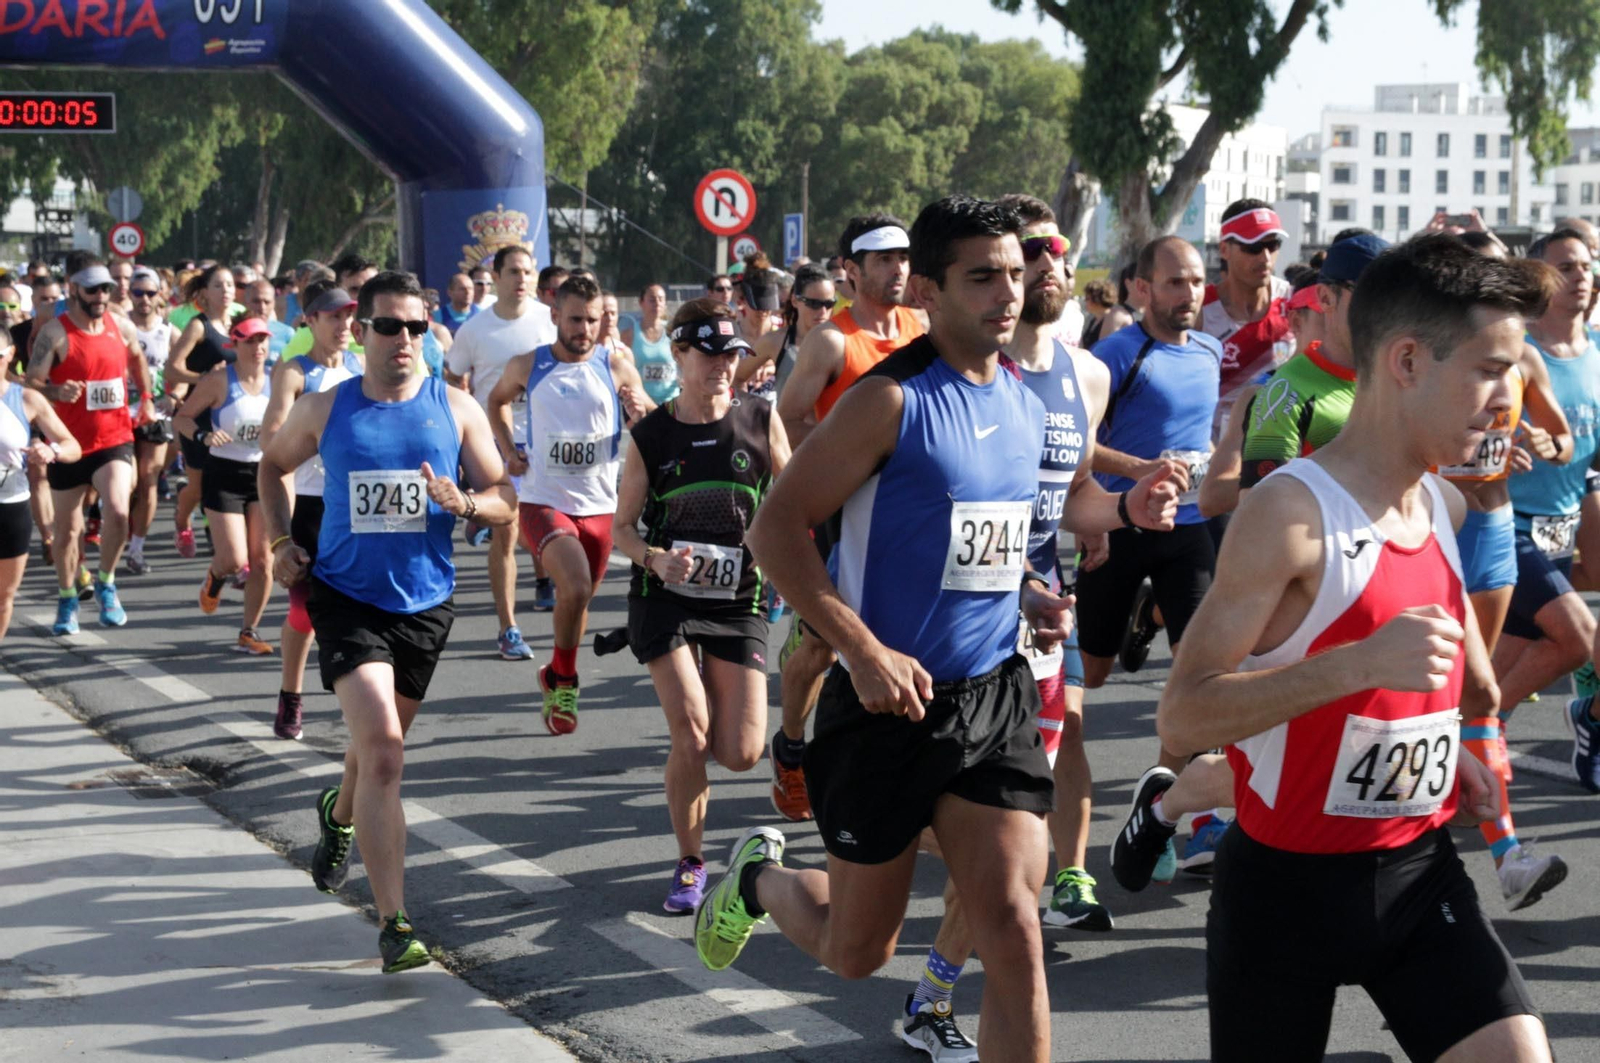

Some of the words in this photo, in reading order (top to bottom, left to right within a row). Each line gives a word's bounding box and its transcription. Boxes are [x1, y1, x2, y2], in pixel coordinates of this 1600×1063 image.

[0, 100, 98, 126] 0:00:05
[117, 233, 138, 246] 40
[737, 244, 756, 256] 40
[91, 387, 122, 404] 406
[550, 441, 595, 465] 4088
[356, 482, 420, 515] 3243
[956, 519, 1024, 566] 3244
[1345, 734, 1451, 801] 4293
